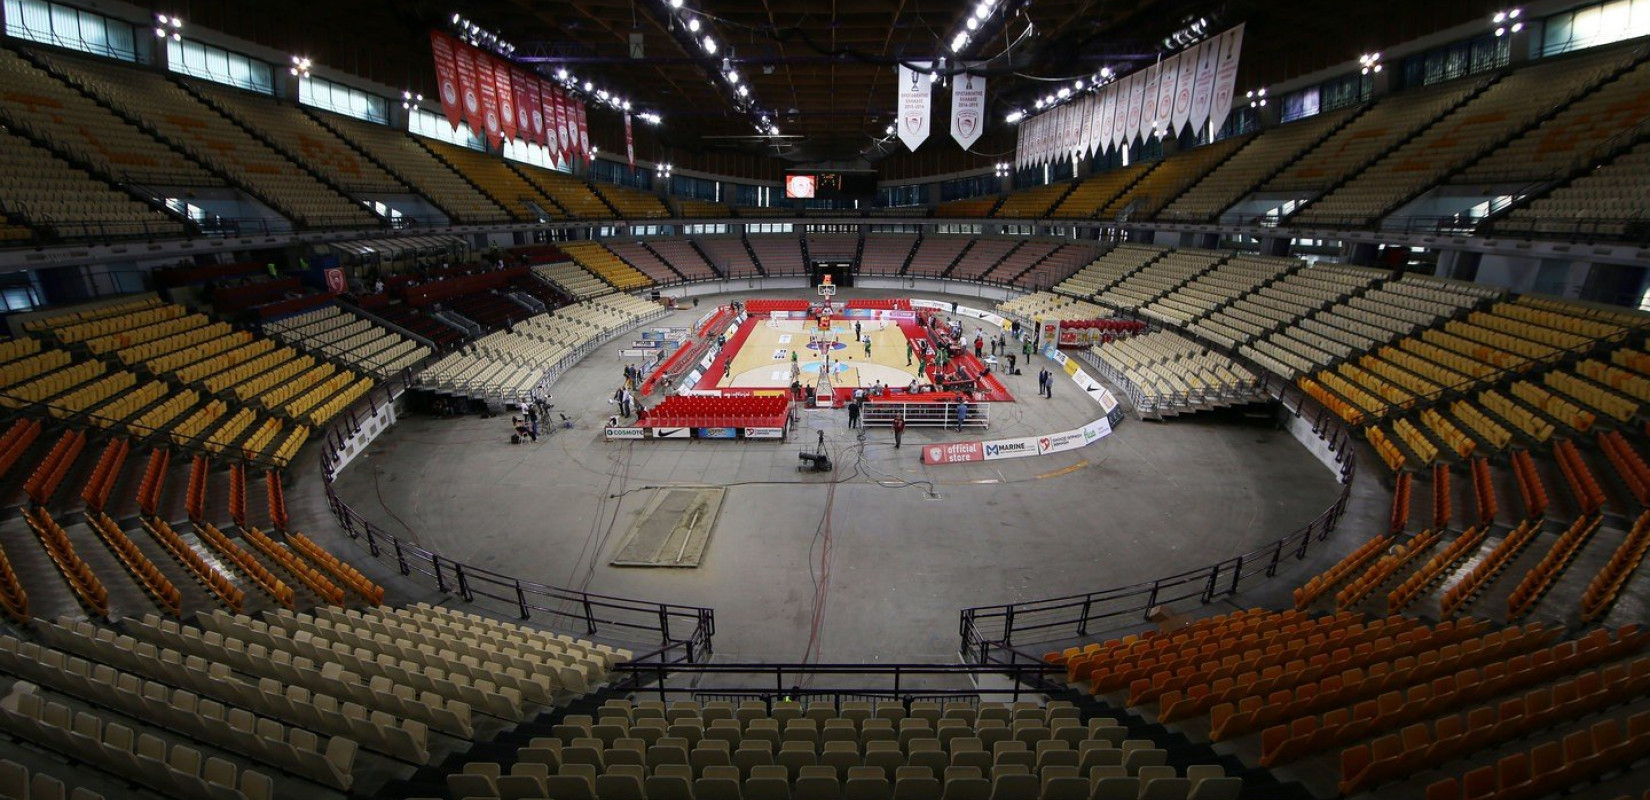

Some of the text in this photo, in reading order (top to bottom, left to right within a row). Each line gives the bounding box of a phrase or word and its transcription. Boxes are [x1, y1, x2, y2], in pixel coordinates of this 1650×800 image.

[947, 443, 976, 454] official
[998, 442, 1025, 451] MARINE
[949, 453, 971, 462] store
